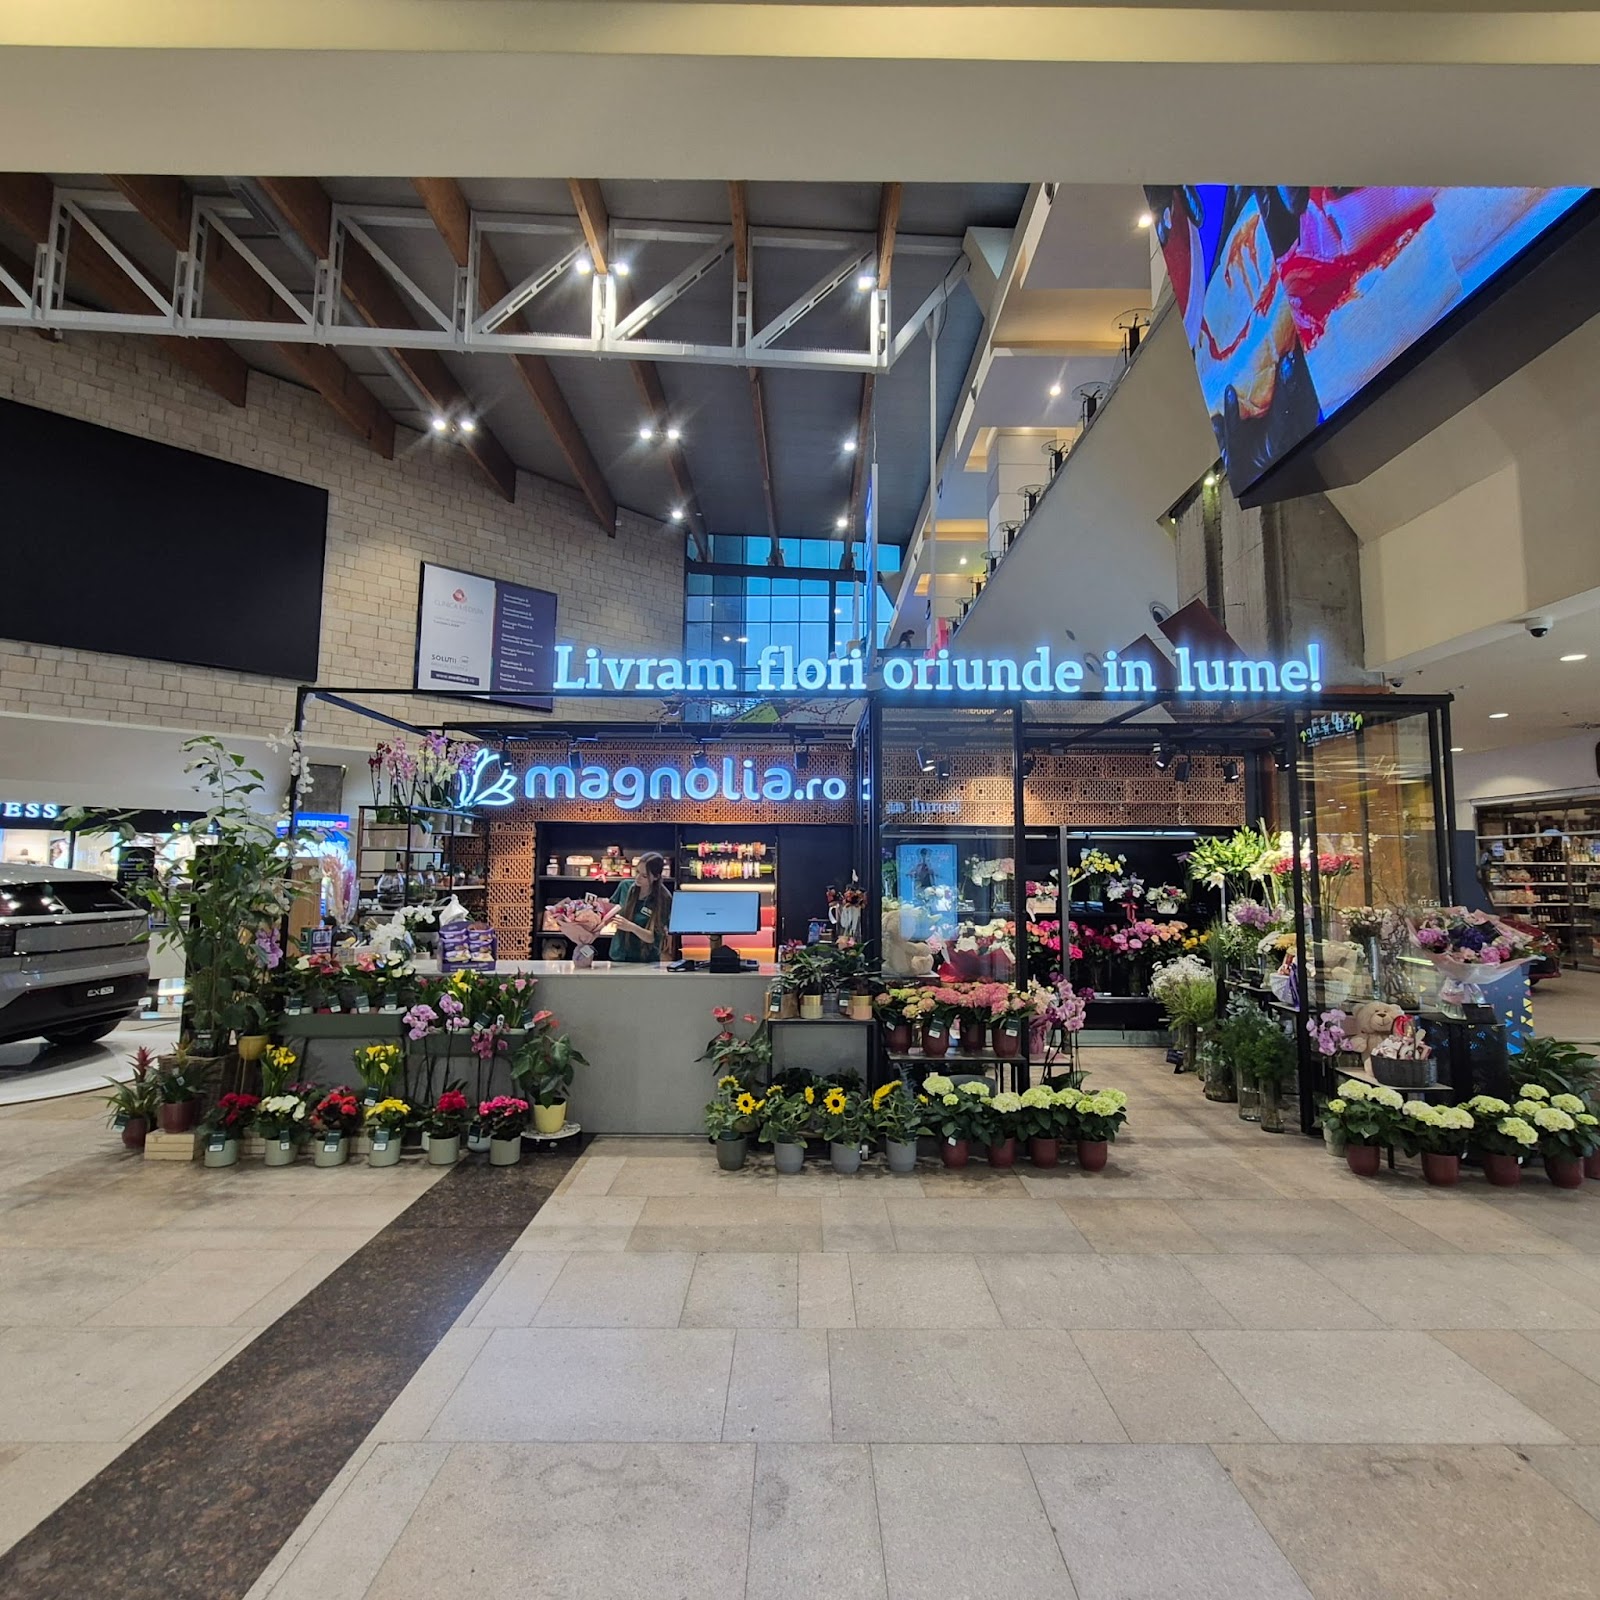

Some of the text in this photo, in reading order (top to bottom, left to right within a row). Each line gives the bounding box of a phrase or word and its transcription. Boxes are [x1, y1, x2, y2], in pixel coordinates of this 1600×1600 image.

[553, 643, 1322, 692] Livram flori oriunde in lume!
[524, 757, 847, 810] magnolia.ro
